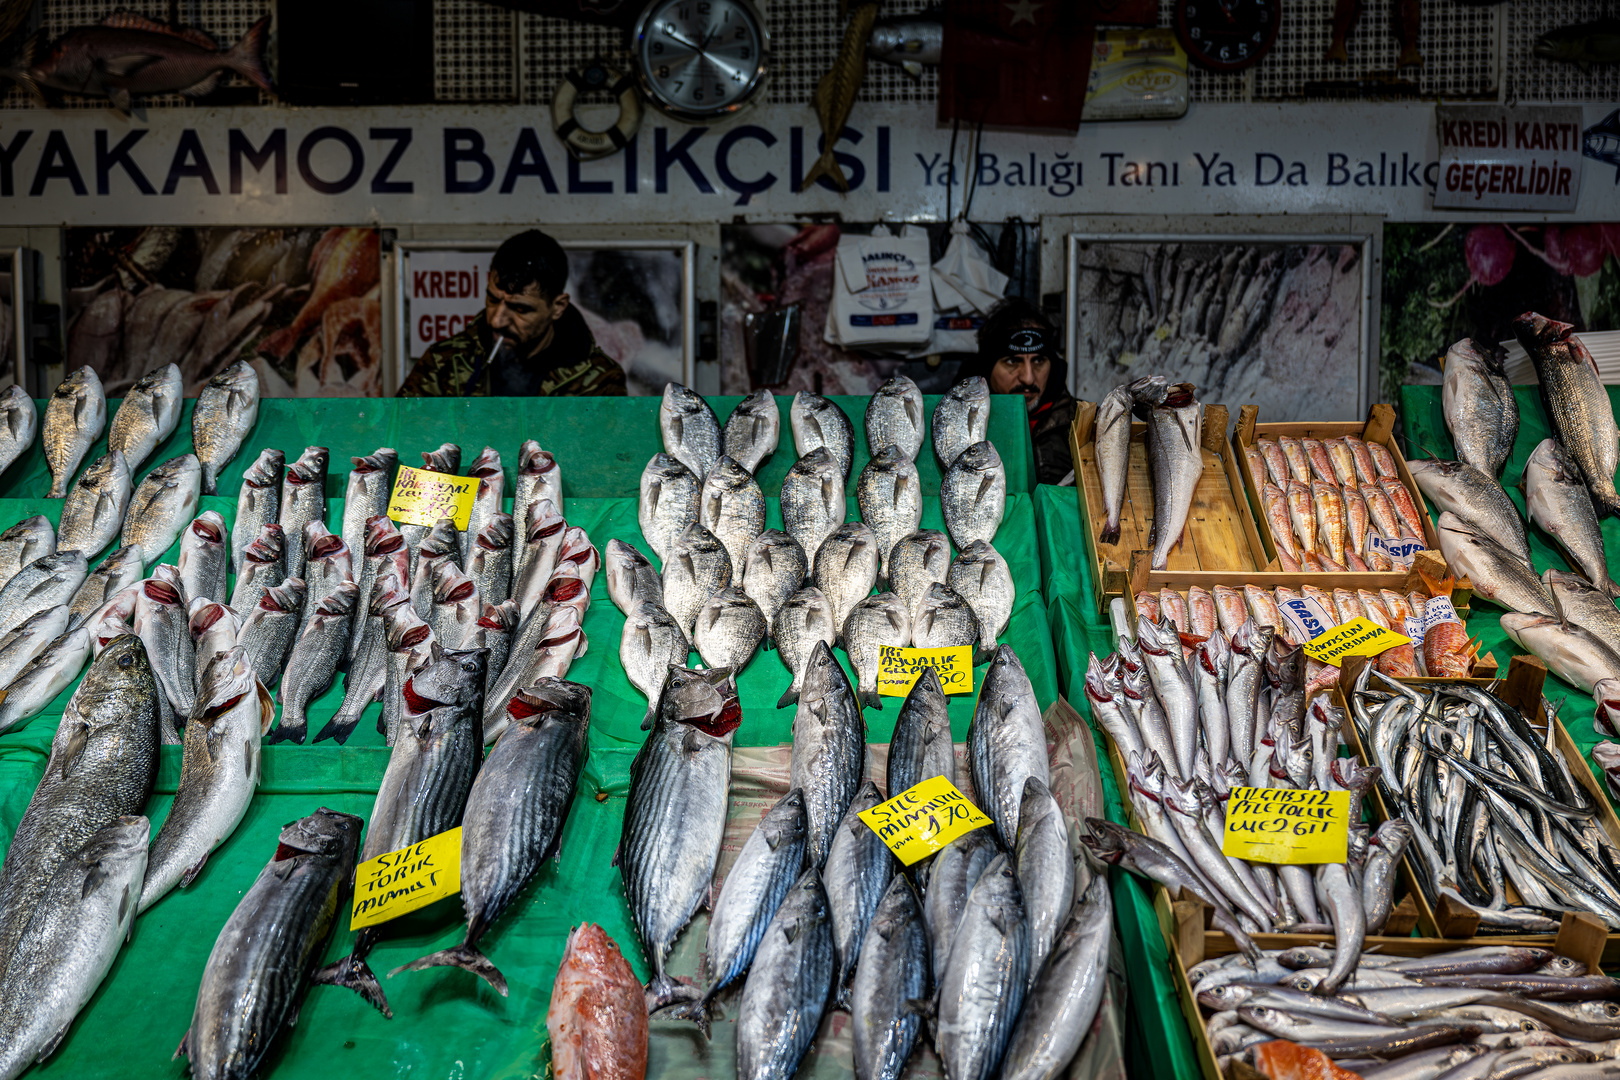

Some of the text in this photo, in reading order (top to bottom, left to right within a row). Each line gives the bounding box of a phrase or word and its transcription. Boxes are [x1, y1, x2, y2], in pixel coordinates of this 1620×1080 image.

[723, 11, 729, 22] 1
[735, 26, 746, 39] 2
[1190, 26, 1201, 40] 8
[653, 42, 663, 54] 9
[740, 47, 750, 60] 3
[1203, 40, 1213, 54] 7
[1219, 45, 1230, 59] 6
[1238, 41, 1248, 57] 5
[659, 65, 670, 78] 8
[674, 81, 684, 93] 7
[693, 88, 704, 100] 6
[715, 84, 725, 96] 5
[1443, 116, 1578, 151] KREDİ KARTI
[0, 126, 890, 206] YAKAMOZ BALIKÇISI
[915, 153, 958, 186] Ya
[977, 152, 1083, 197] Balığı
[1101, 153, 1179, 186] Tanı
[1193, 152, 1236, 186] Ya
[1255, 152, 1308, 186] Da
[1445, 160, 1572, 200] GEÇERLİDİR
[414, 265, 479, 298] KREDİ
